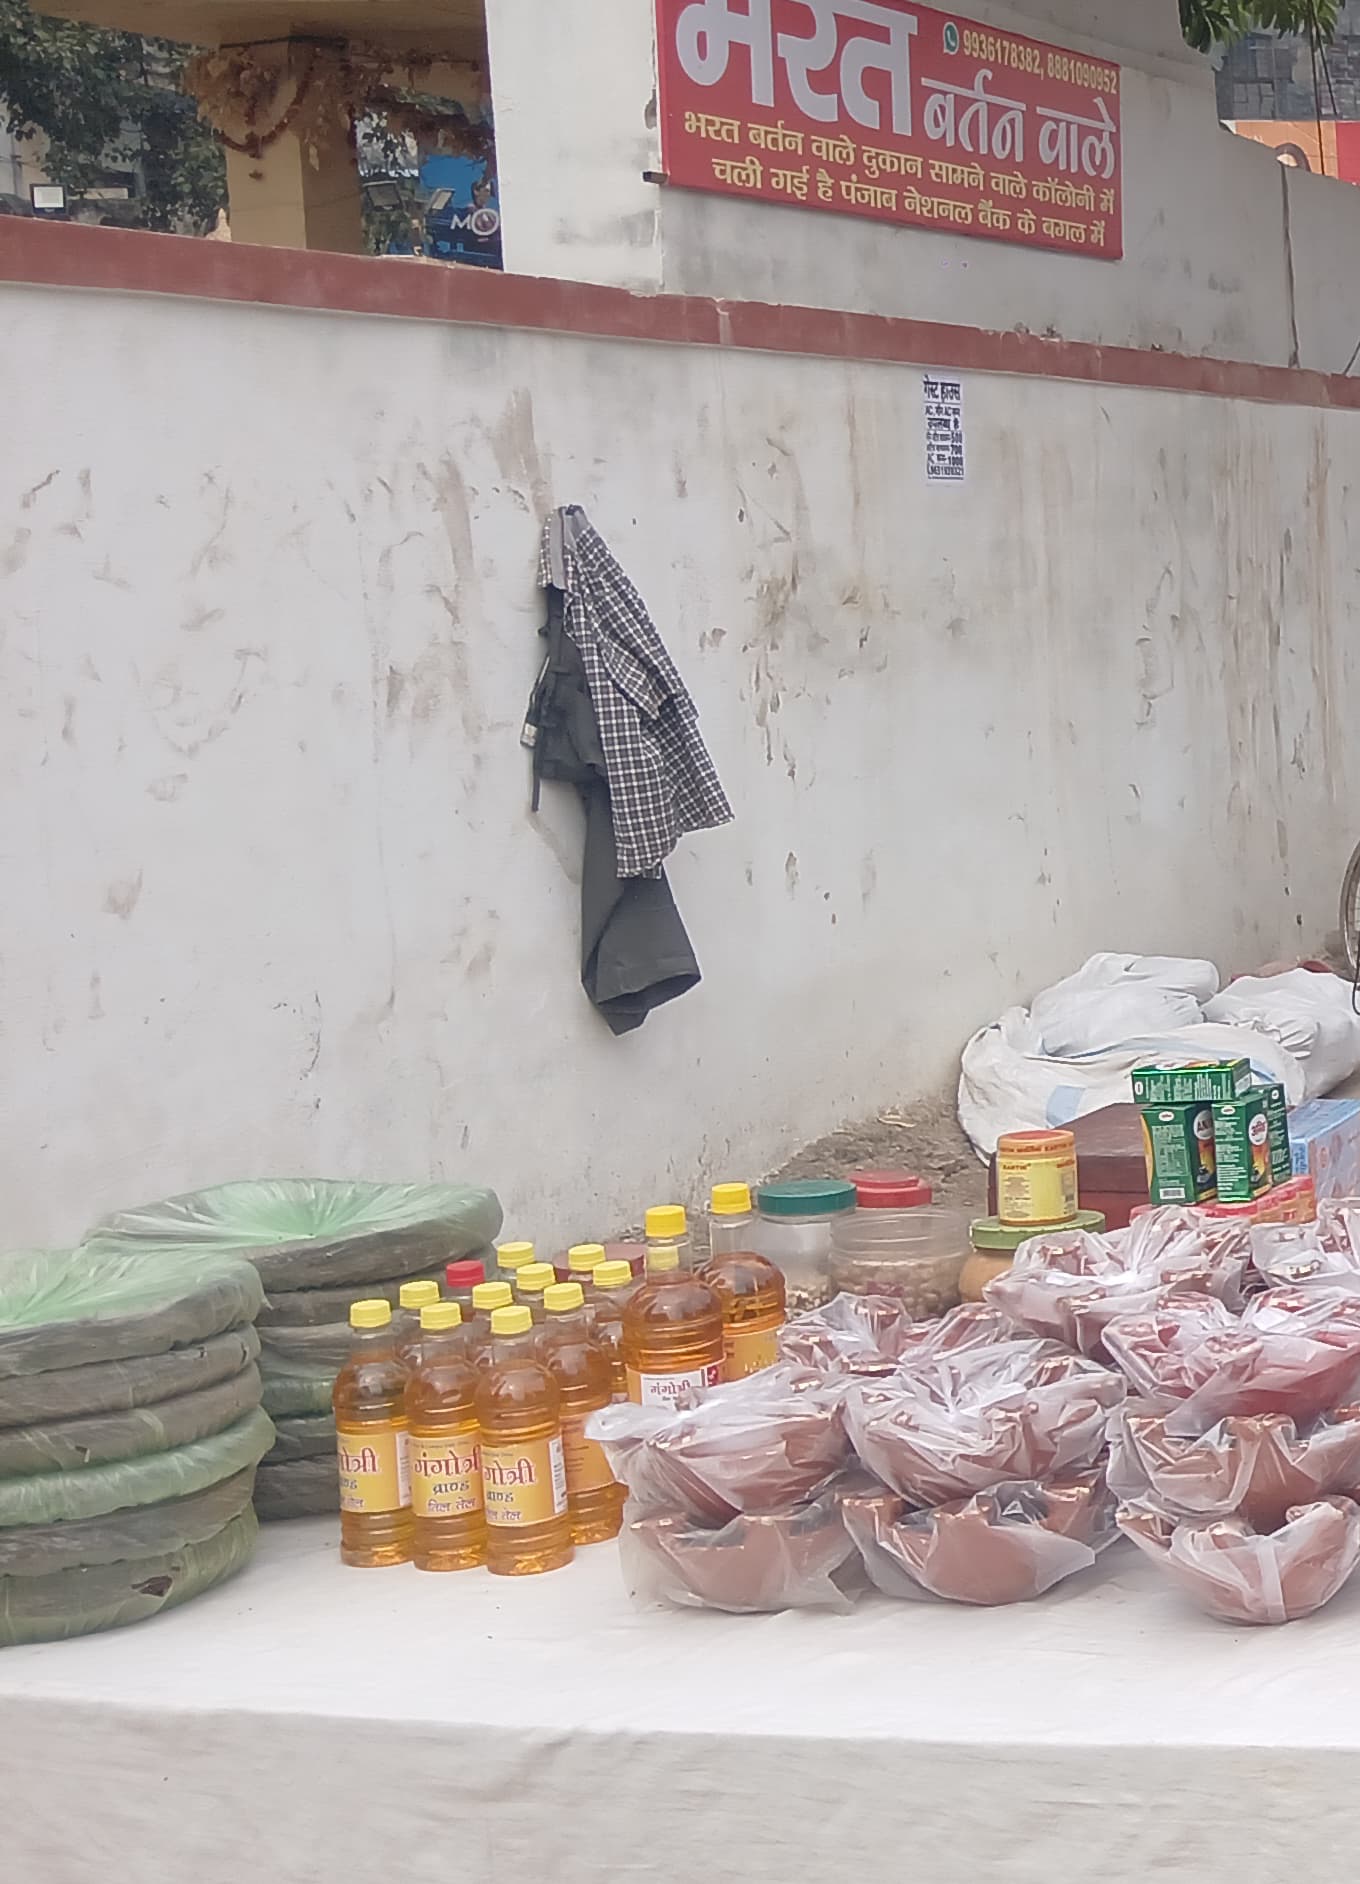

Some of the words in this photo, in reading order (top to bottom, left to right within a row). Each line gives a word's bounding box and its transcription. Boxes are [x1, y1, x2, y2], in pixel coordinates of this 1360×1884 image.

[963, 28, 1044, 75] 9936178382,
[1047, 54, 1118, 95] 8881090952
[684, 110, 741, 144] भरत
[748, 120, 804, 156] बर्तन
[811, 130, 854, 165] वाले
[862, 144, 924, 179] दुकान
[929, 156, 984, 190] सामने
[990, 166, 1027, 199] वाले
[1032, 173, 1095, 212] कॉलोनी
[1097, 187, 1115, 215] में
[921, 69, 1026, 162] बर्तन
[1036, 97, 1116, 180] वाले
[712, 155, 762, 190] चली
[770, 162, 808, 200] गई
[817, 169, 834, 203] है
[840, 174, 898, 212] पंजाब
[905, 184, 973, 225] नेशनल
[978, 199, 1011, 231] बैंक
[1017, 212, 1037, 236] के
[1042, 215, 1086, 244] बगल
[1090, 219, 1106, 247] में
